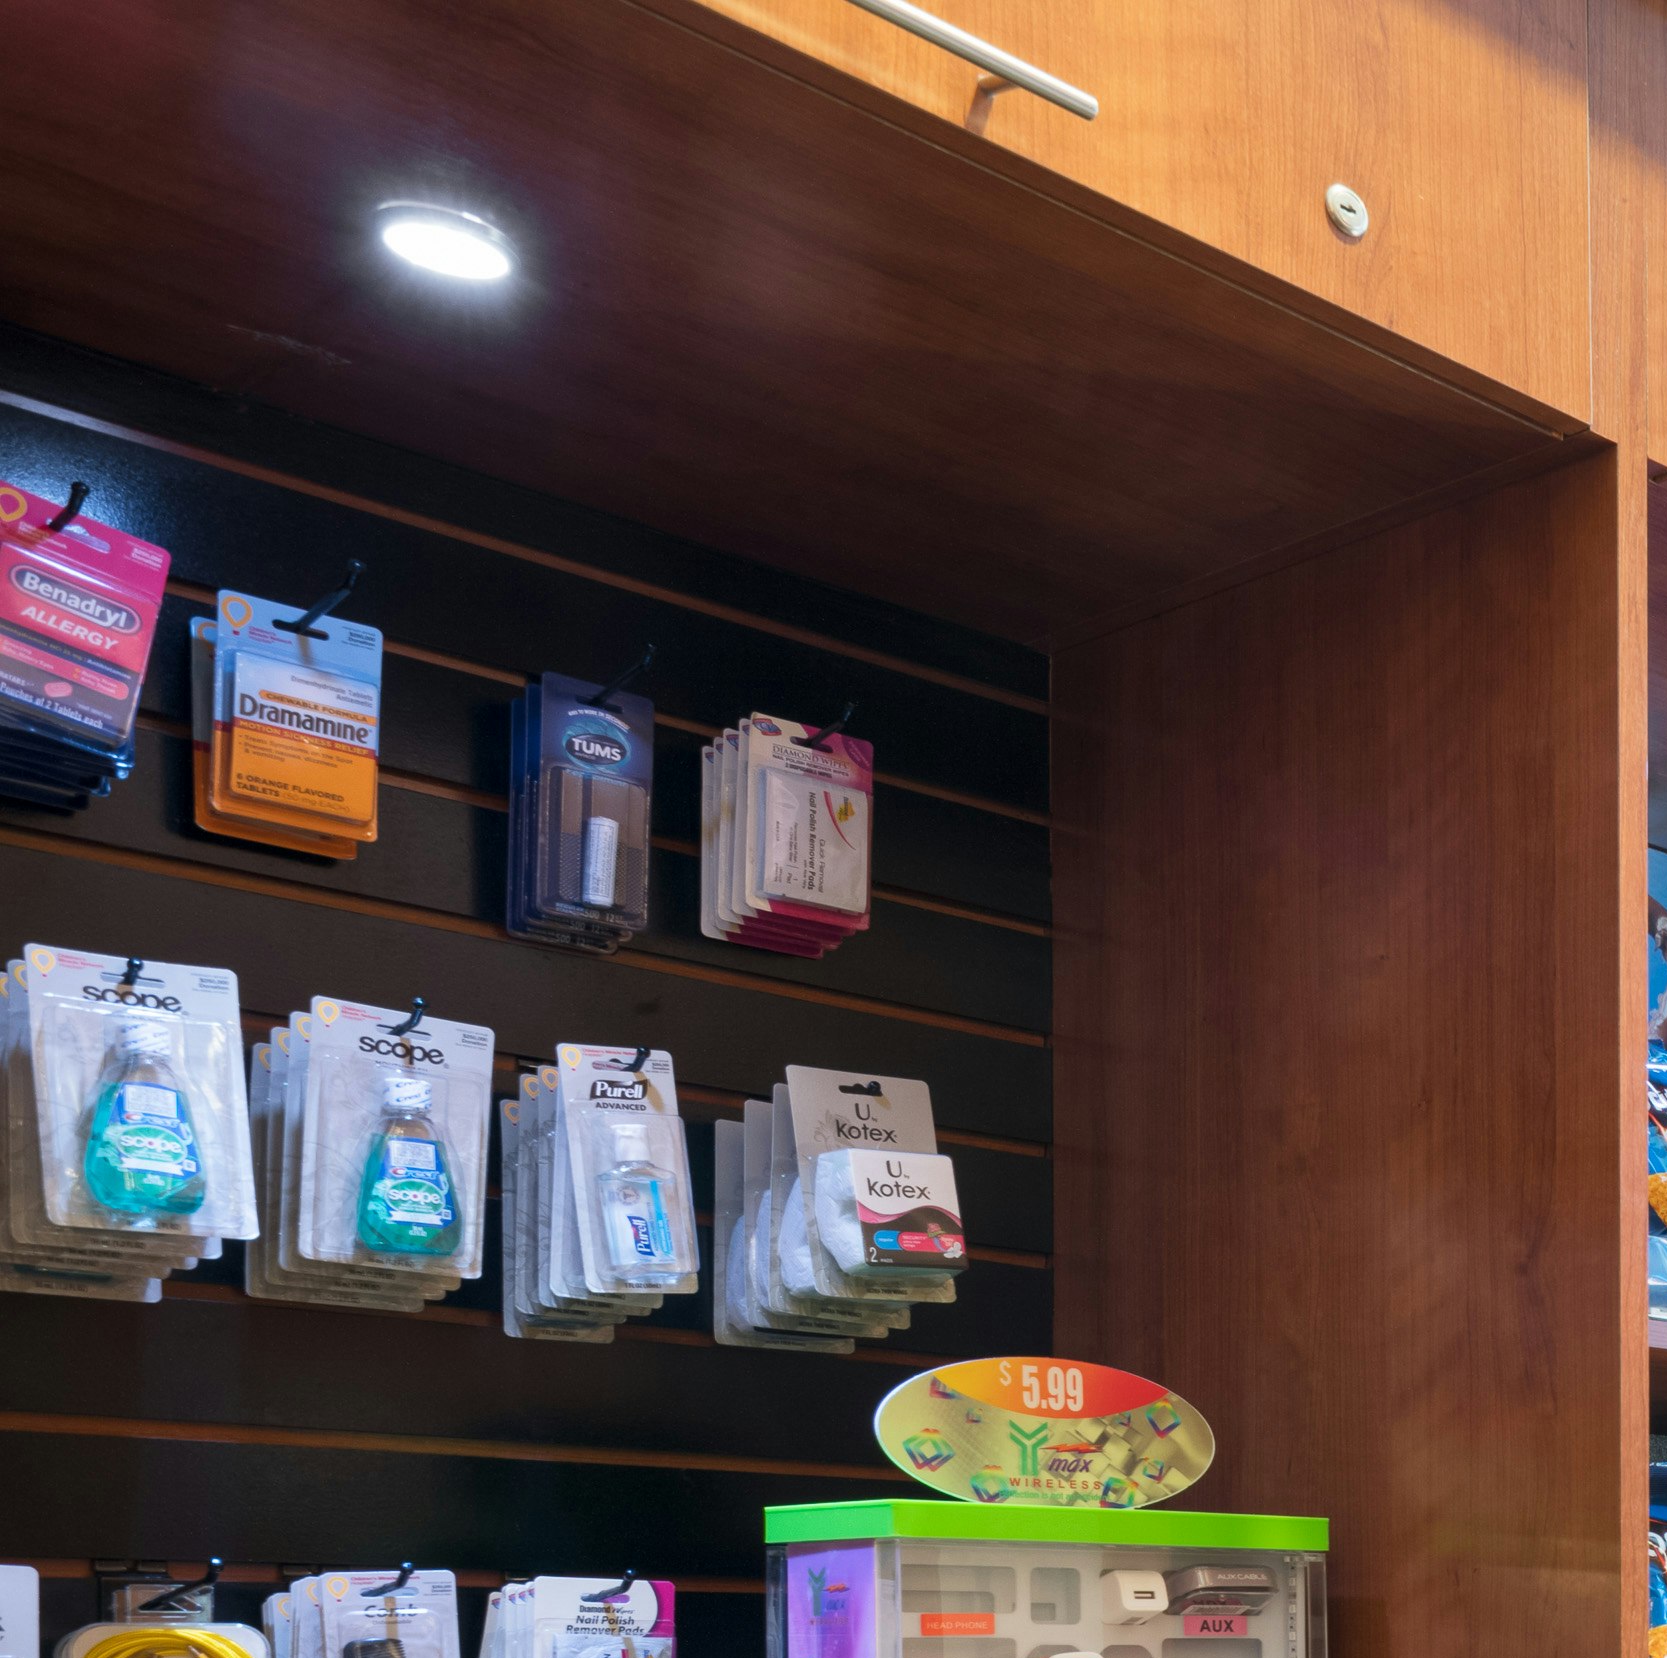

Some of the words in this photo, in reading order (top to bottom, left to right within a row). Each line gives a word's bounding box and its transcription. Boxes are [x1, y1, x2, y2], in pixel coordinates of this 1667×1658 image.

[22, 571, 128, 629] Benadryl
[20, 606, 119, 650] ALLERGY
[239, 693, 370, 745] Dramamine
[571, 737, 623, 762] TUMS
[236, 781, 281, 798] TABLETS
[246, 773, 290, 791] ORANGE
[292, 784, 346, 802] FLAVORED
[808, 808, 818, 833] Polish
[807, 832, 818, 869] Remover
[807, 869, 817, 891] Pads
[82, 984, 182, 1012] scope
[359, 1036, 445, 1066] scope
[595, 1080, 644, 1100] Purell
[595, 1101, 647, 1111] ADVANCED
[855, 1103, 872, 1121] U
[120, 1135, 183, 1155] scope
[886, 1160, 903, 1179] U
[387, 1187, 441, 1204] scope
[636, 1218, 651, 1255] Purell
[869, 1247, 879, 1264] 2
[1048, 1456, 1095, 1473] max
[1009, 1477, 1101, 1490] WIRELESS
[576, 1615, 599, 1625] Nail
[601, 1616, 635, 1626] Polish
[954, 1621, 988, 1631] PHONE
[1200, 1620, 1235, 1633] AUX
